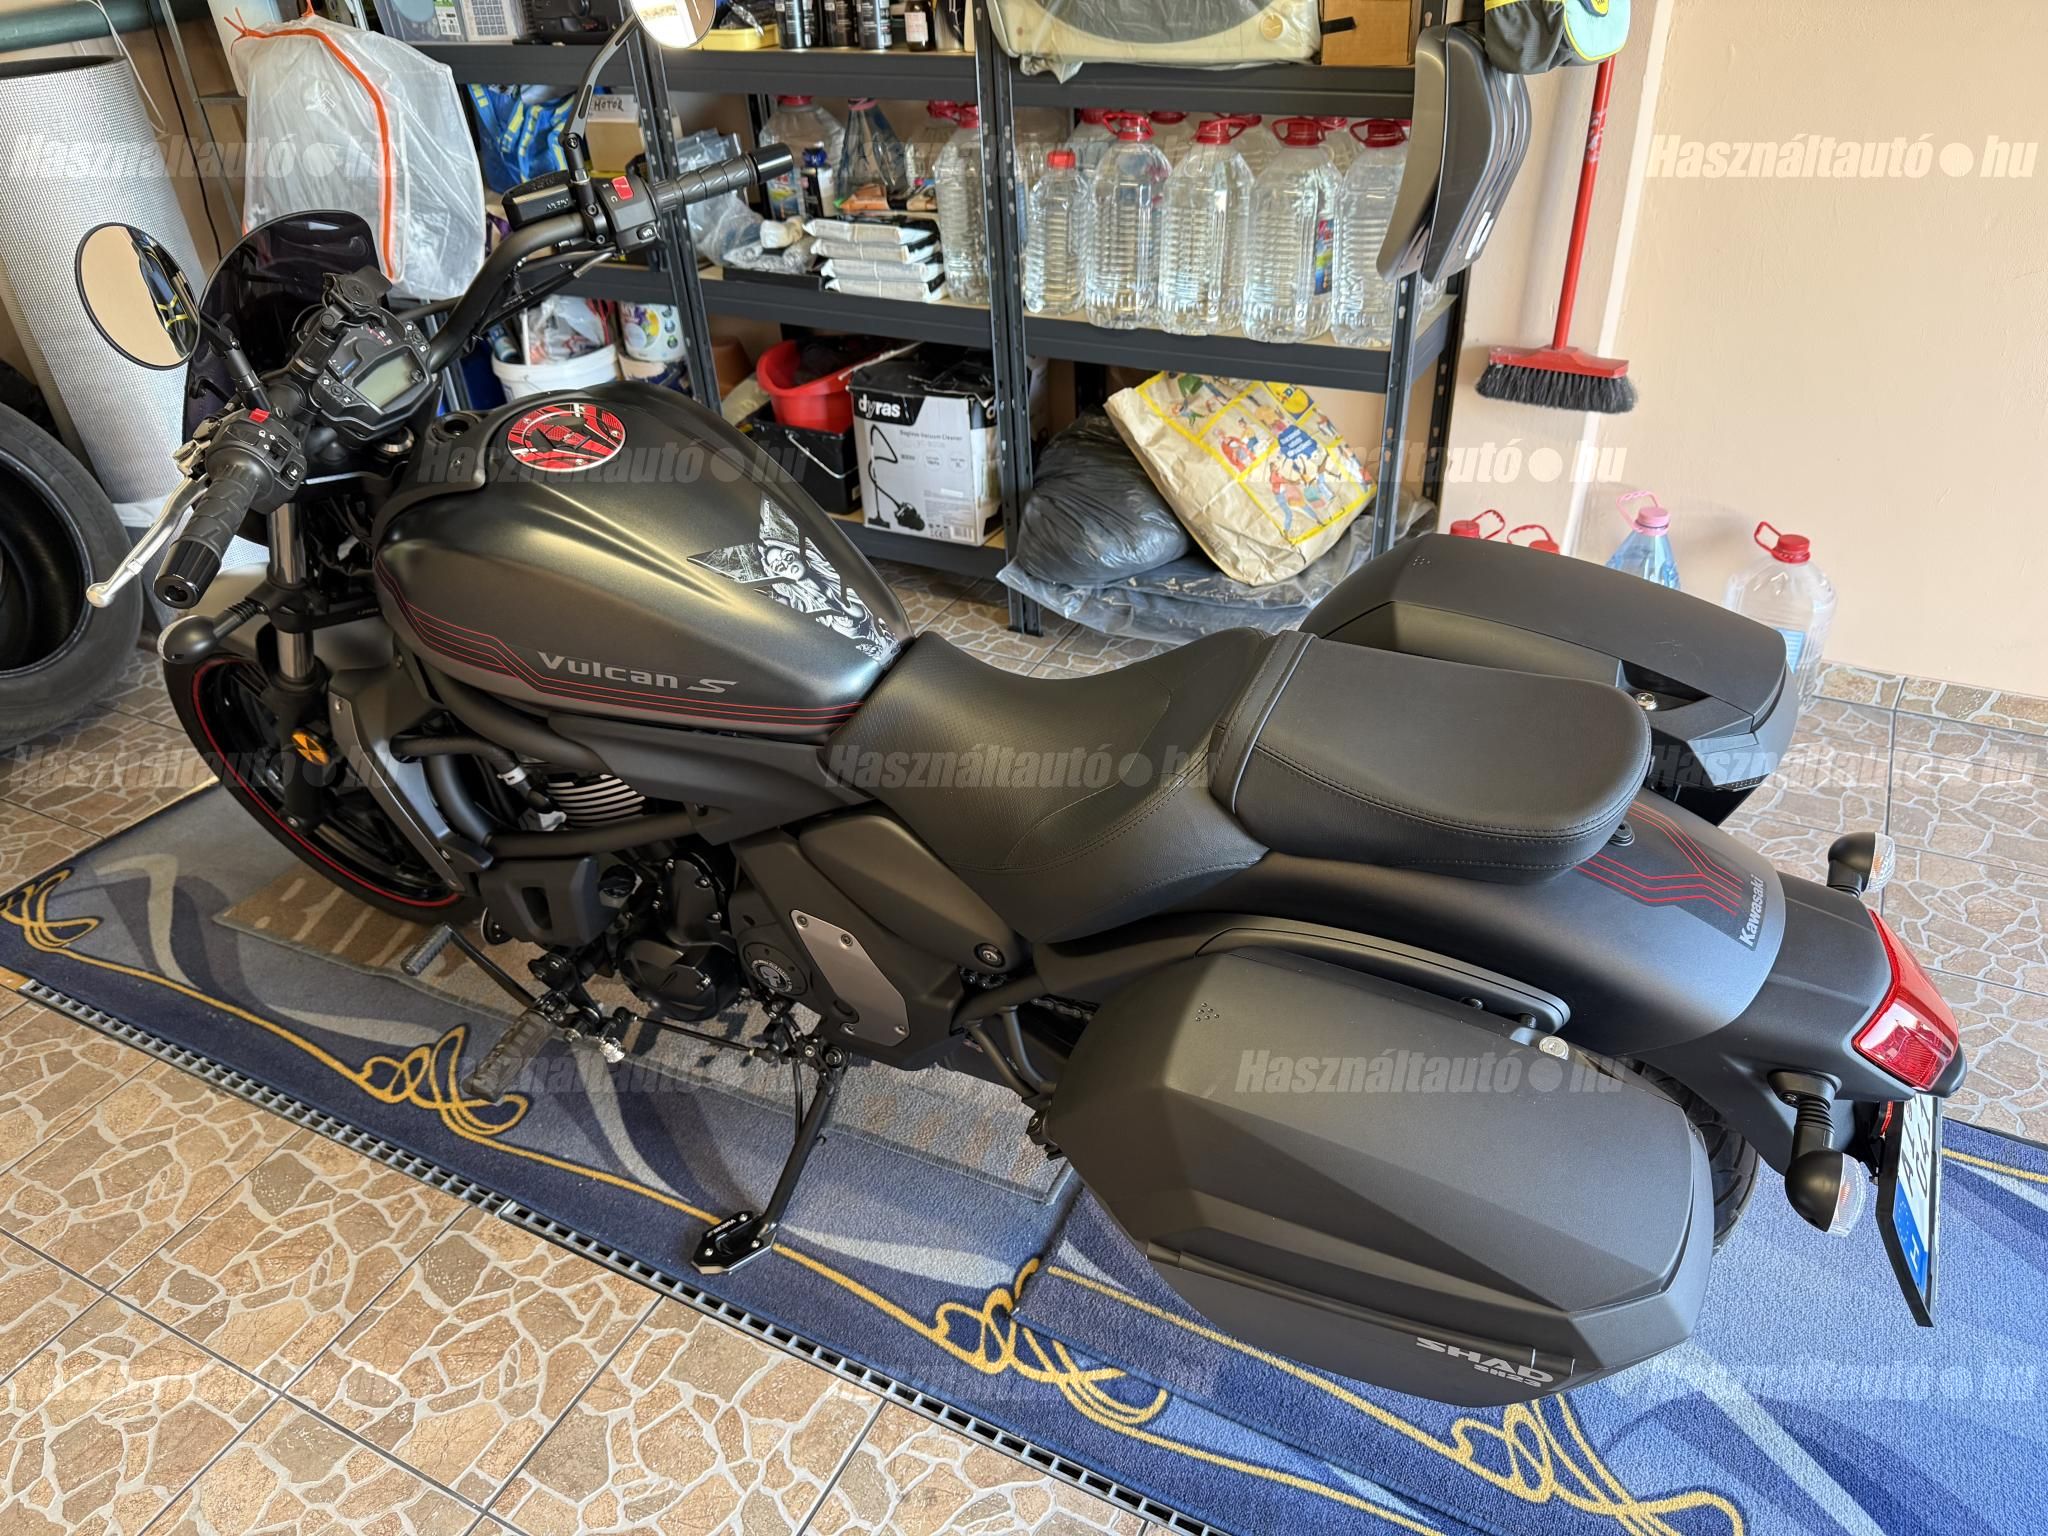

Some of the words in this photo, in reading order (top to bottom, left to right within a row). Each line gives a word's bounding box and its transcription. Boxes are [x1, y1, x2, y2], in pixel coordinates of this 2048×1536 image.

[858, 394, 901, 418] dyras
[537, 650, 678, 689] Vulcan
[686, 678, 740, 694] S
[1739, 873, 1764, 947] Kawasaki
[1416, 1337, 1554, 1383] SHAD
[1473, 1363, 1542, 1388] SH23
